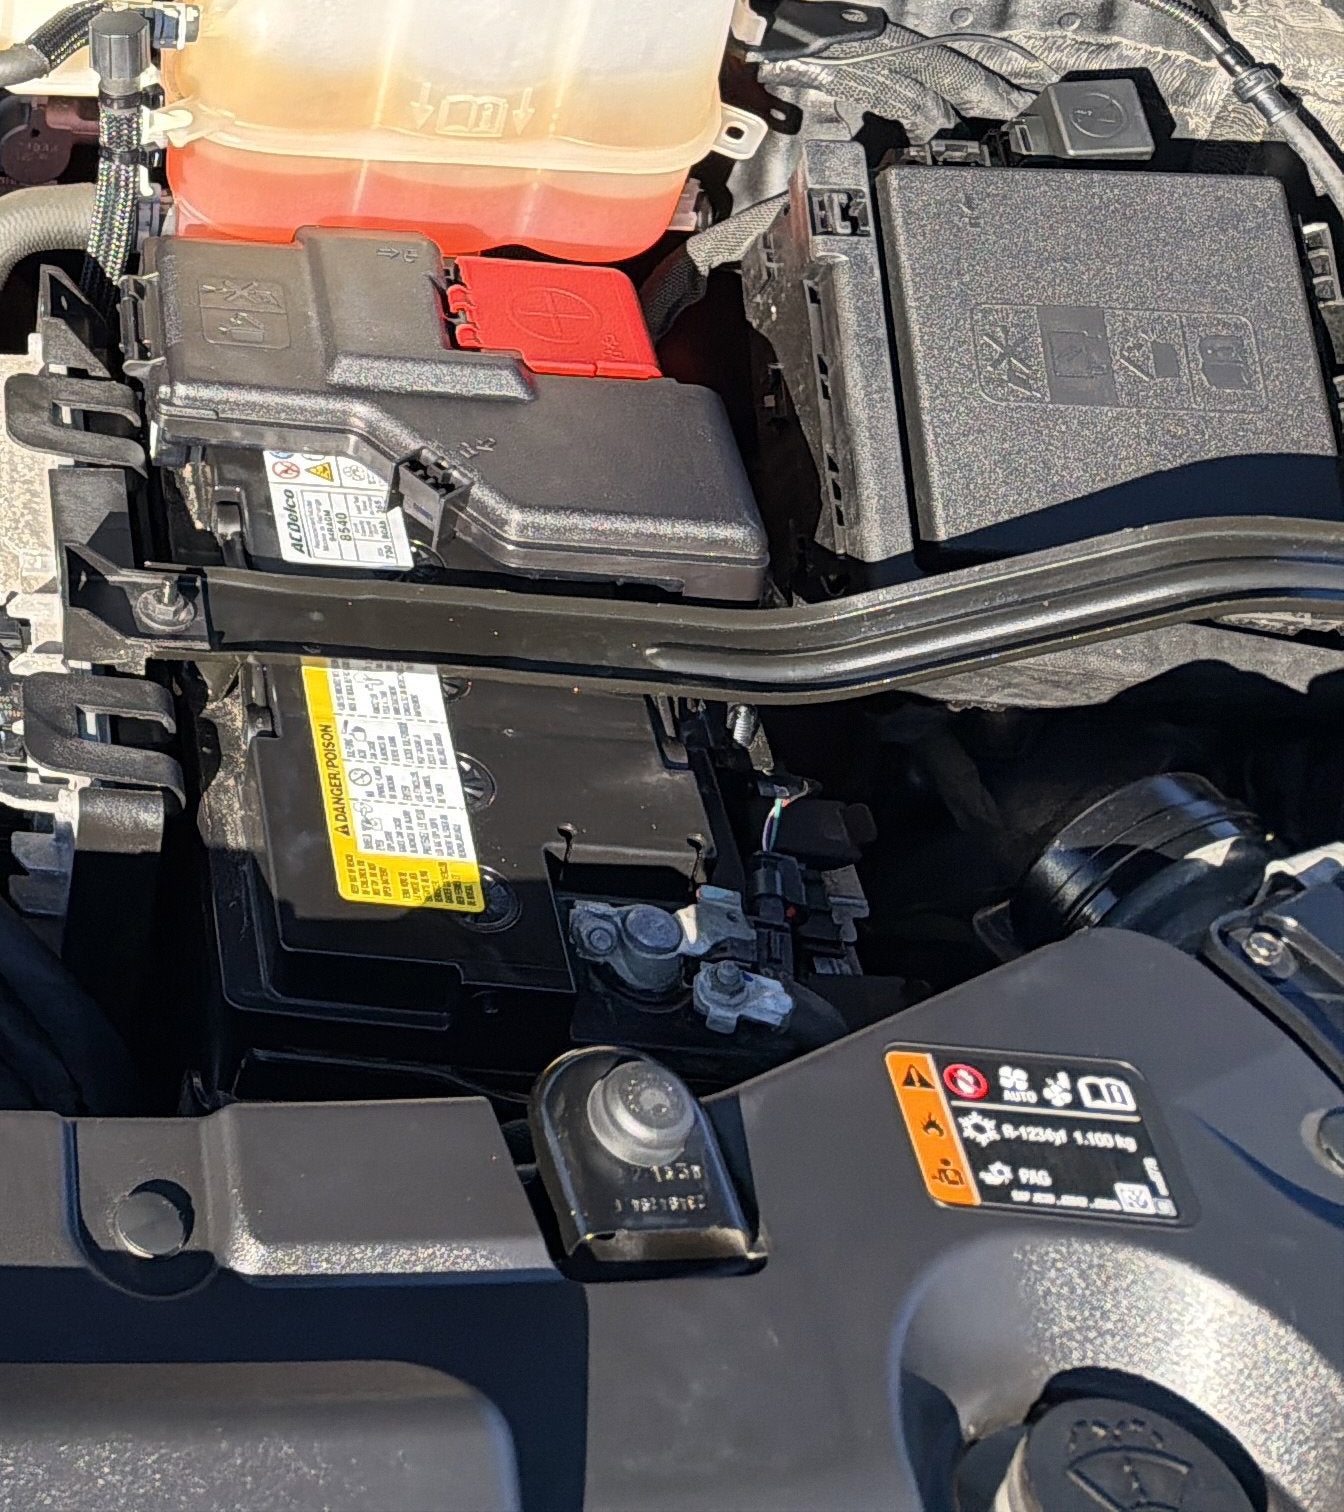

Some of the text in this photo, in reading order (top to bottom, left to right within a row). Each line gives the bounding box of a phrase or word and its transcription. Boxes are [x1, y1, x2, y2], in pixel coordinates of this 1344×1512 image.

[279, 488, 306, 554] ACDelco
[333, 511, 353, 542] 8540
[318, 723, 348, 823] DANGER/POISON
[1003, 1090, 1038, 1104] AUTO
[1073, 1130, 1112, 1148] 1.100
[1018, 1168, 1052, 1186] PAG
